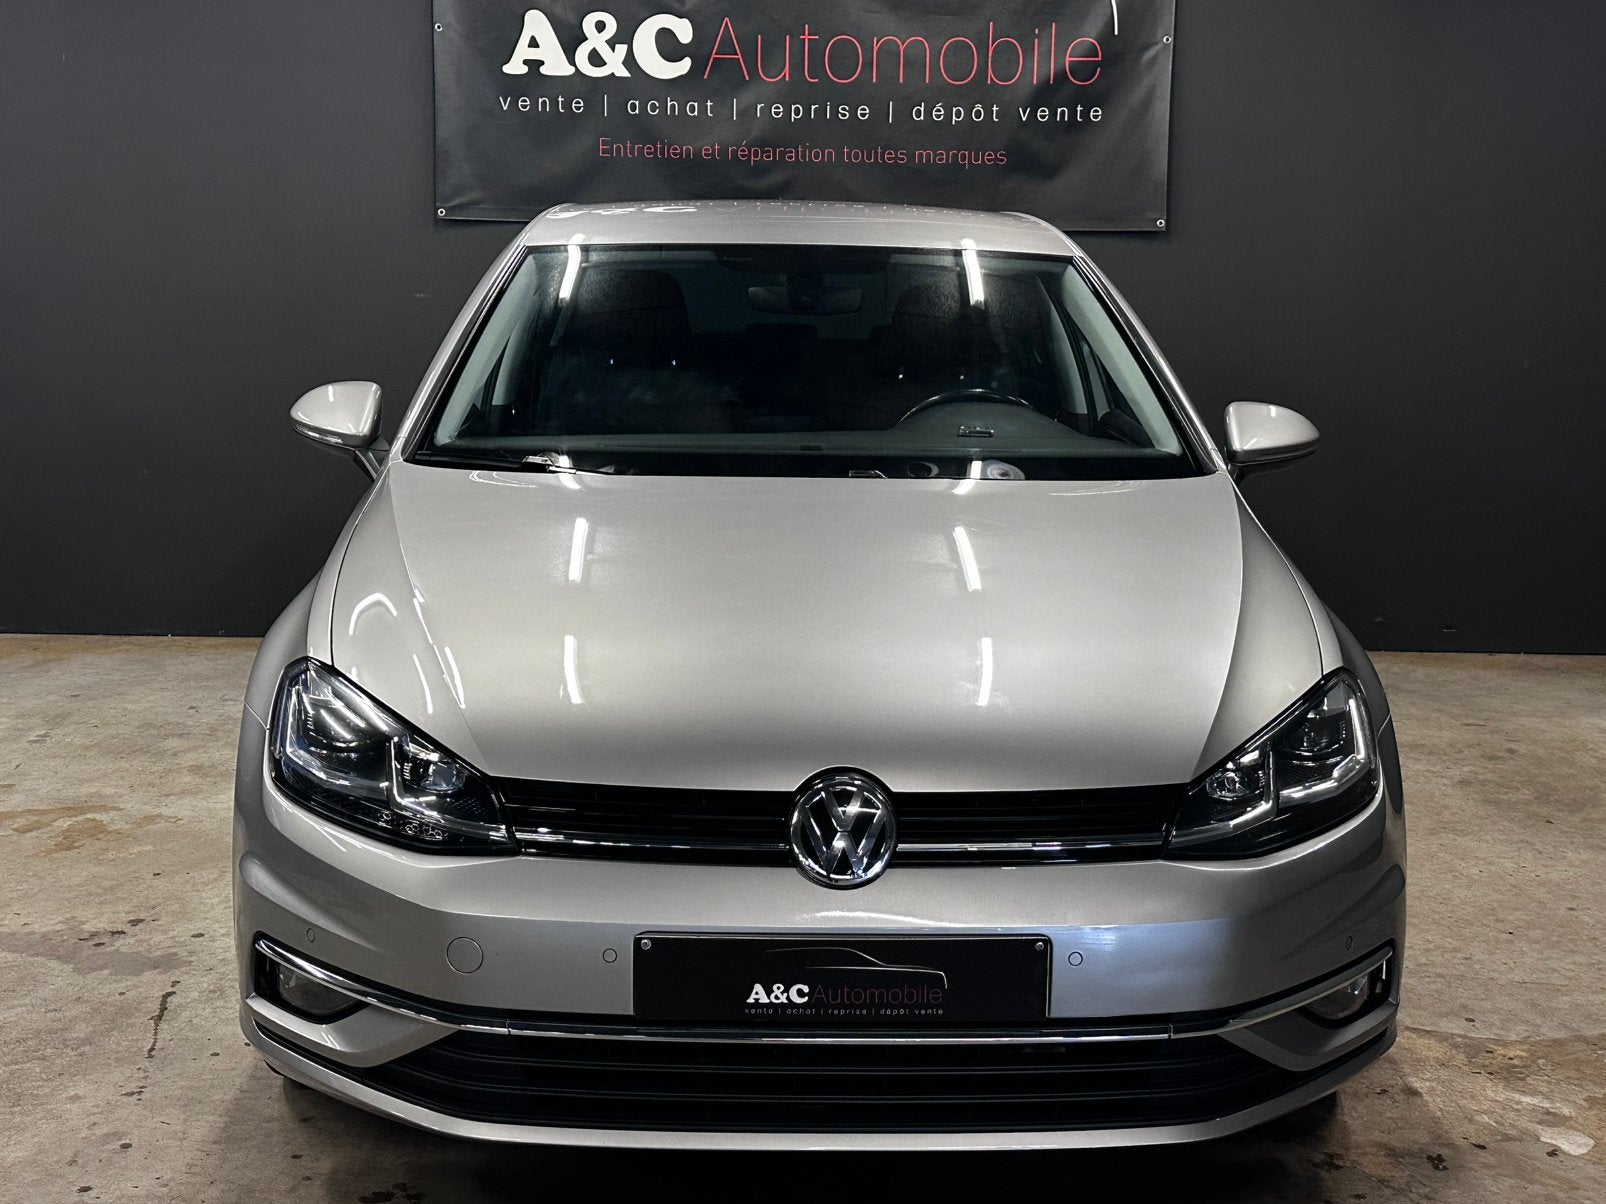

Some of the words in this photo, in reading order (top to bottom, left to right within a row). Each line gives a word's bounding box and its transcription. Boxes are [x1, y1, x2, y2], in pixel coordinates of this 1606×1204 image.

[502, 9, 693, 80] A&C
[703, 17, 1103, 86] Automobile
[499, 94, 585, 113] vente
[627, 96, 714, 117] achat
[756, 101, 870, 123] reprise
[912, 101, 1000, 124] dépôt
[1018, 104, 1103, 122] vente
[598, 137, 694, 160] Entretien
[701, 143, 721, 161] et
[727, 140, 835, 166] réparation
[842, 145, 908, 164] toutes
[915, 149, 1008, 169] marques
[746, 983, 810, 1004] A&C
[811, 984, 943, 1005] Automobile
